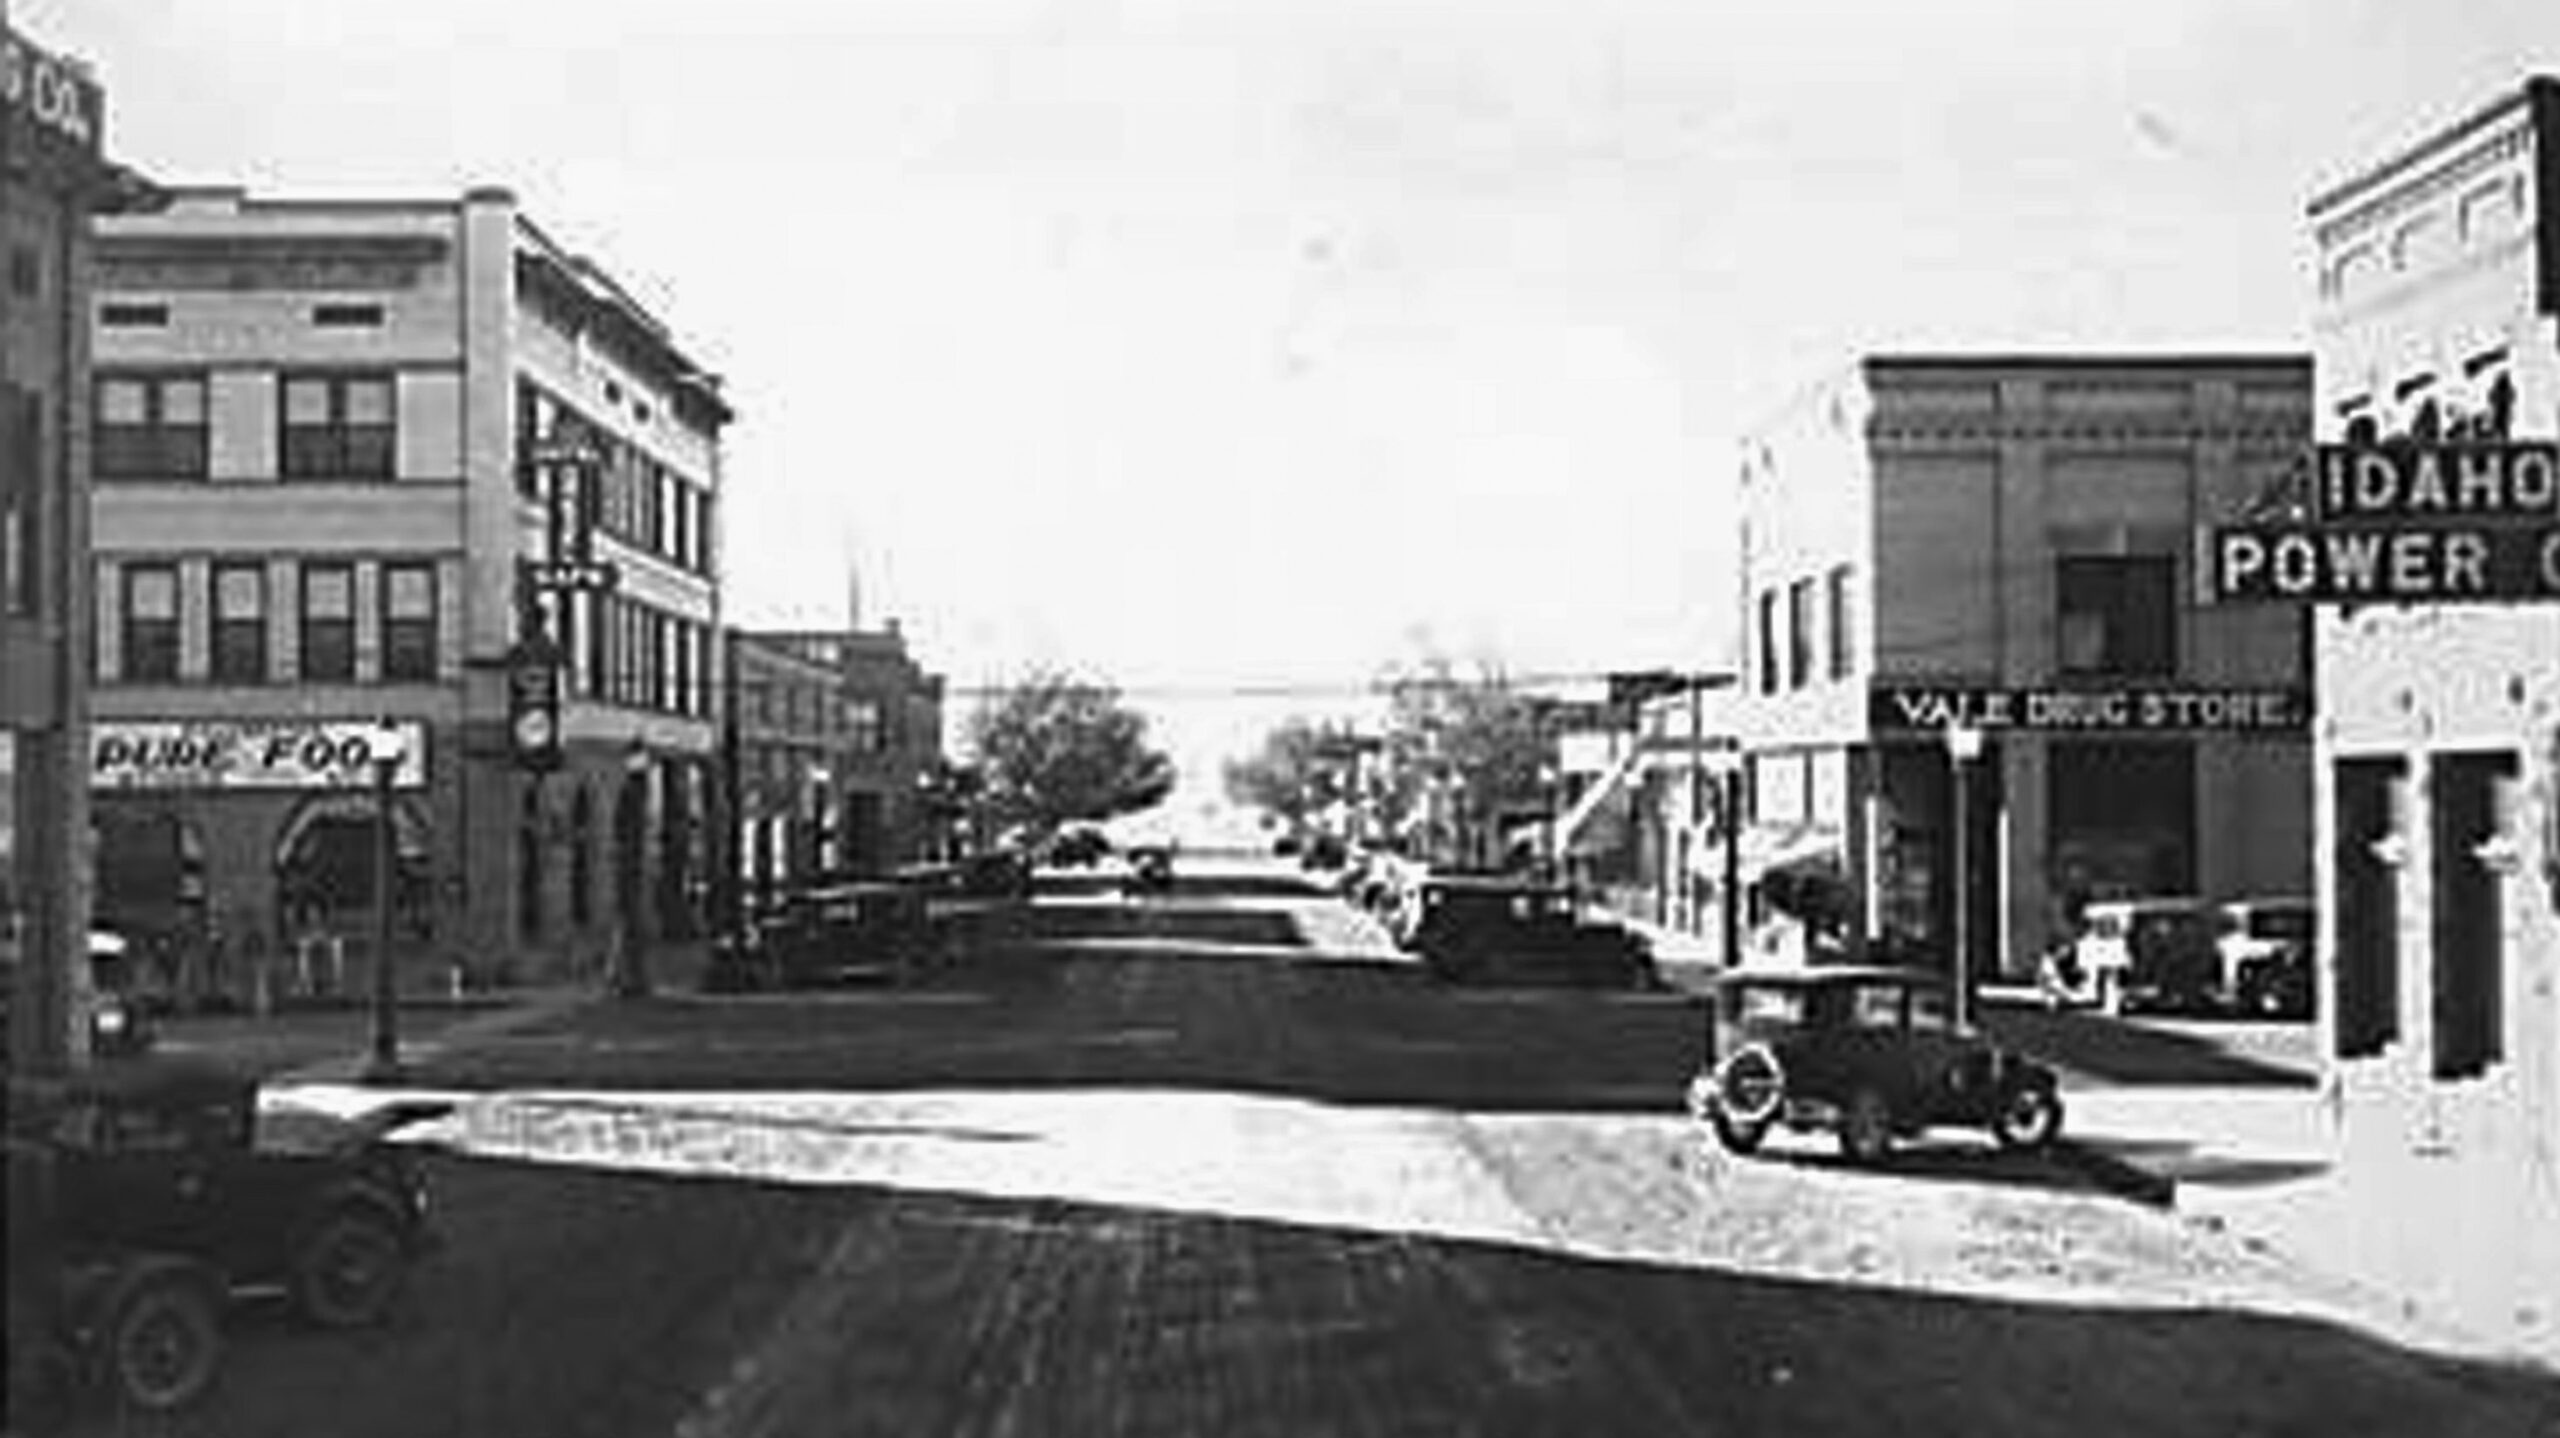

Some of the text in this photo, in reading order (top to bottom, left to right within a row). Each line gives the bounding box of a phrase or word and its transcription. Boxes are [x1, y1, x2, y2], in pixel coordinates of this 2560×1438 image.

[2327, 452, 2552, 508] IDAHO
[2224, 533, 2488, 592] POWER
[1898, 693, 2012, 726] VALE
[2028, 693, 2128, 725] DRUG
[262, 735, 408, 771] FOO
